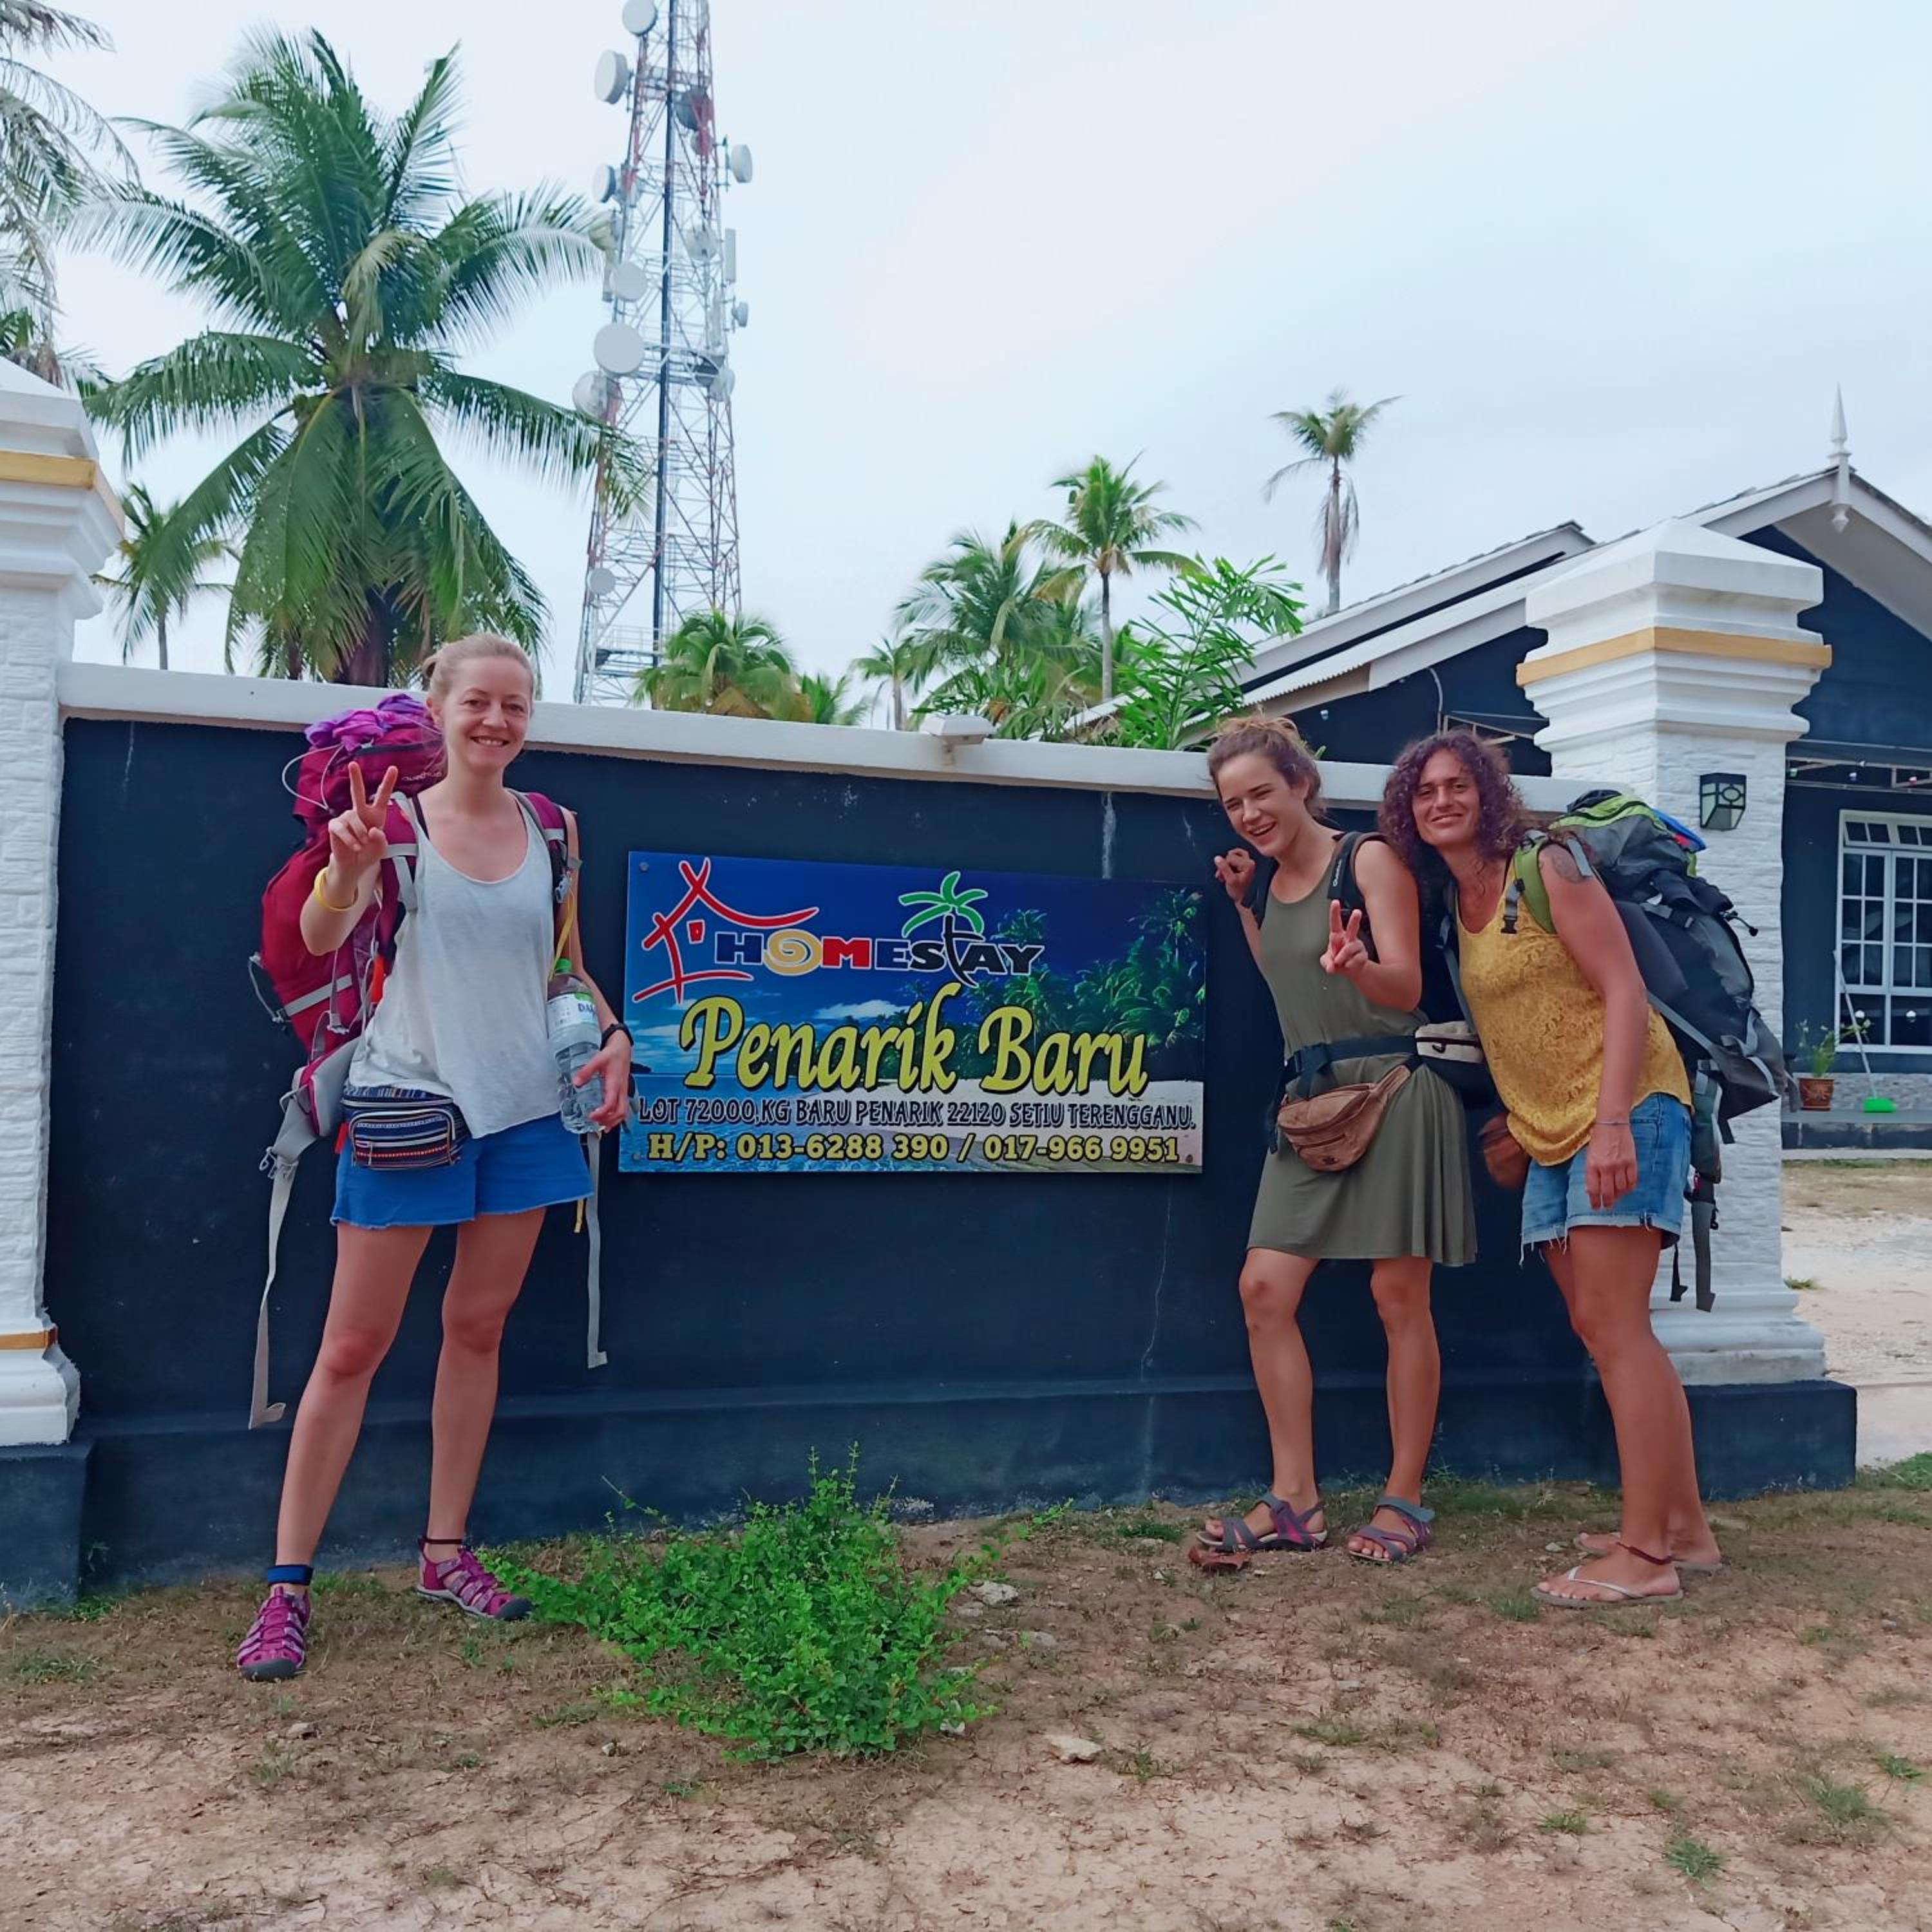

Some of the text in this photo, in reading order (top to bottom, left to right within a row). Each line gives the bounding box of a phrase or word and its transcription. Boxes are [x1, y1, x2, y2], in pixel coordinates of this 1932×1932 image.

[714, 913, 1045, 988] HOMESTAY
[679, 981, 1148, 1096] Penarik Baru
[639, 1097, 680, 1124] LOT
[795, 1099, 851, 1126] BARU
[855, 1099, 943, 1127] PENARIK
[947, 1102, 1006, 1127] 22120
[1009, 1102, 1063, 1128] SETIU
[648, 1132, 1179, 1162] H/P: 013-6288 390 / 017-966 9951
